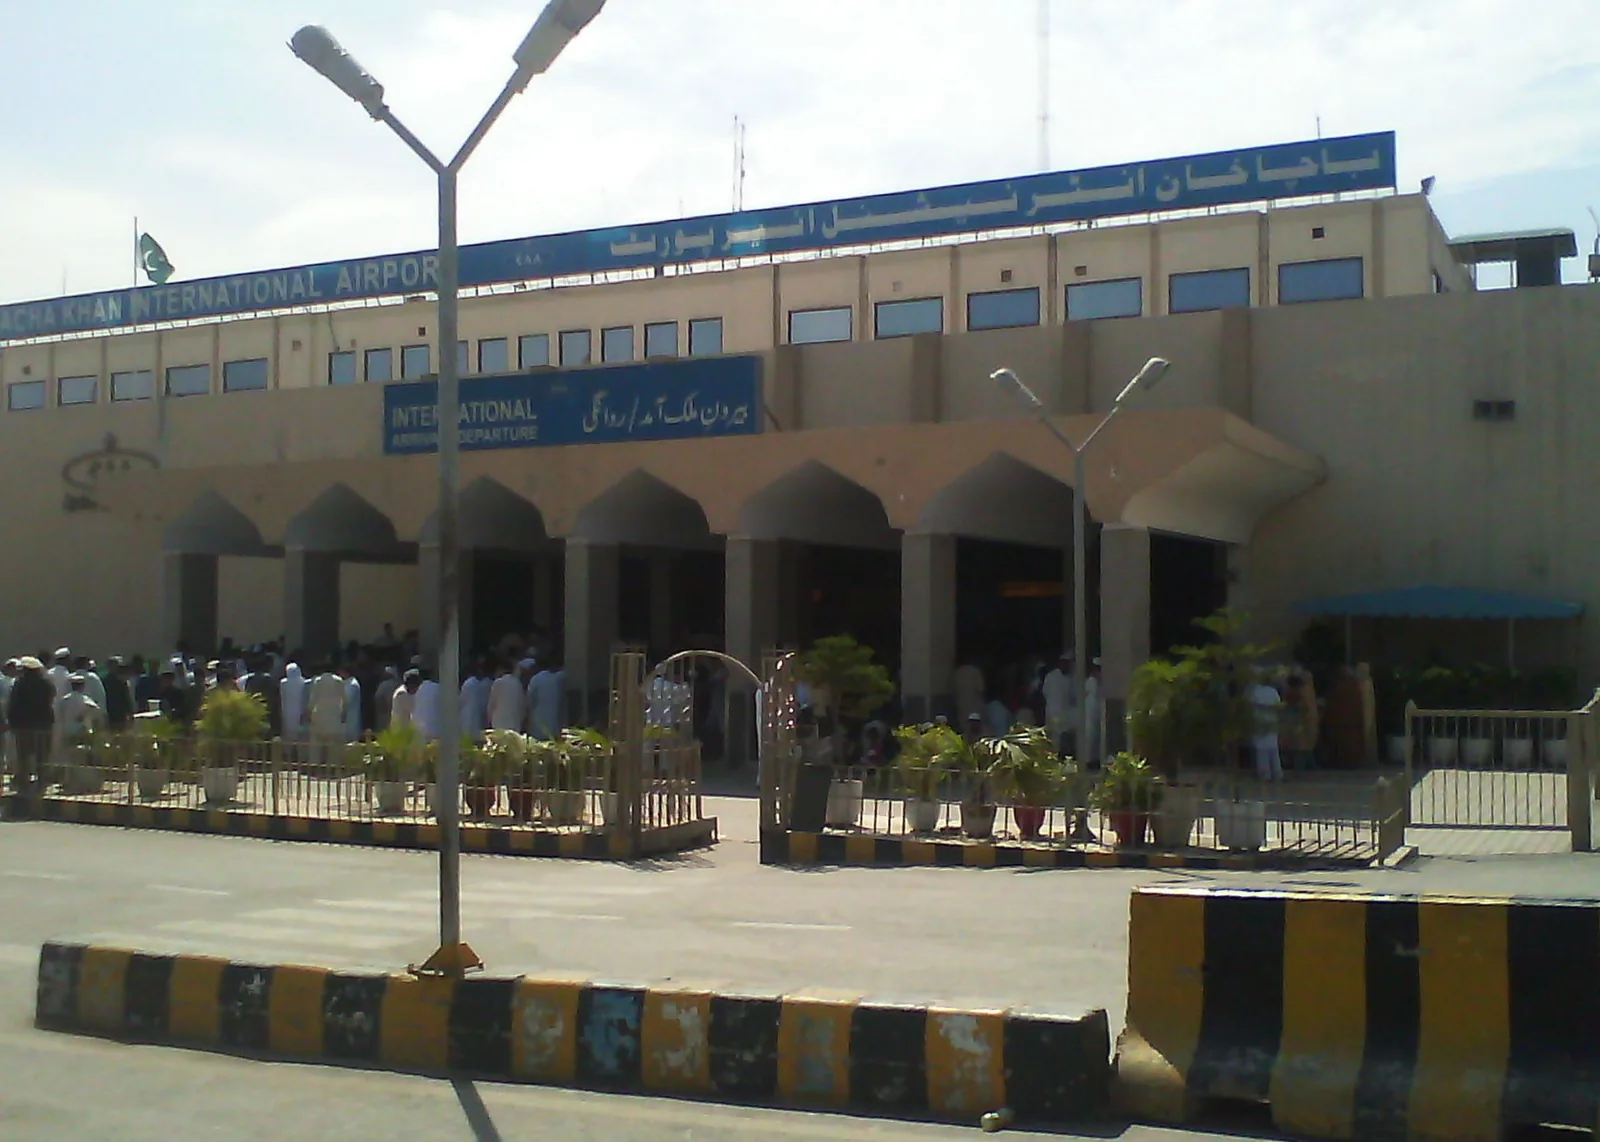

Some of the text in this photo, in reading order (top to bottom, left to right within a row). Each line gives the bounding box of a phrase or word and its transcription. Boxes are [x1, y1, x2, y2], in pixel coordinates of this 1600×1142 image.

[0, 255, 439, 333] ACHA KHAN INTERNATIONAL AIRPOR
[392, 397, 538, 429] INTERATIONAL
